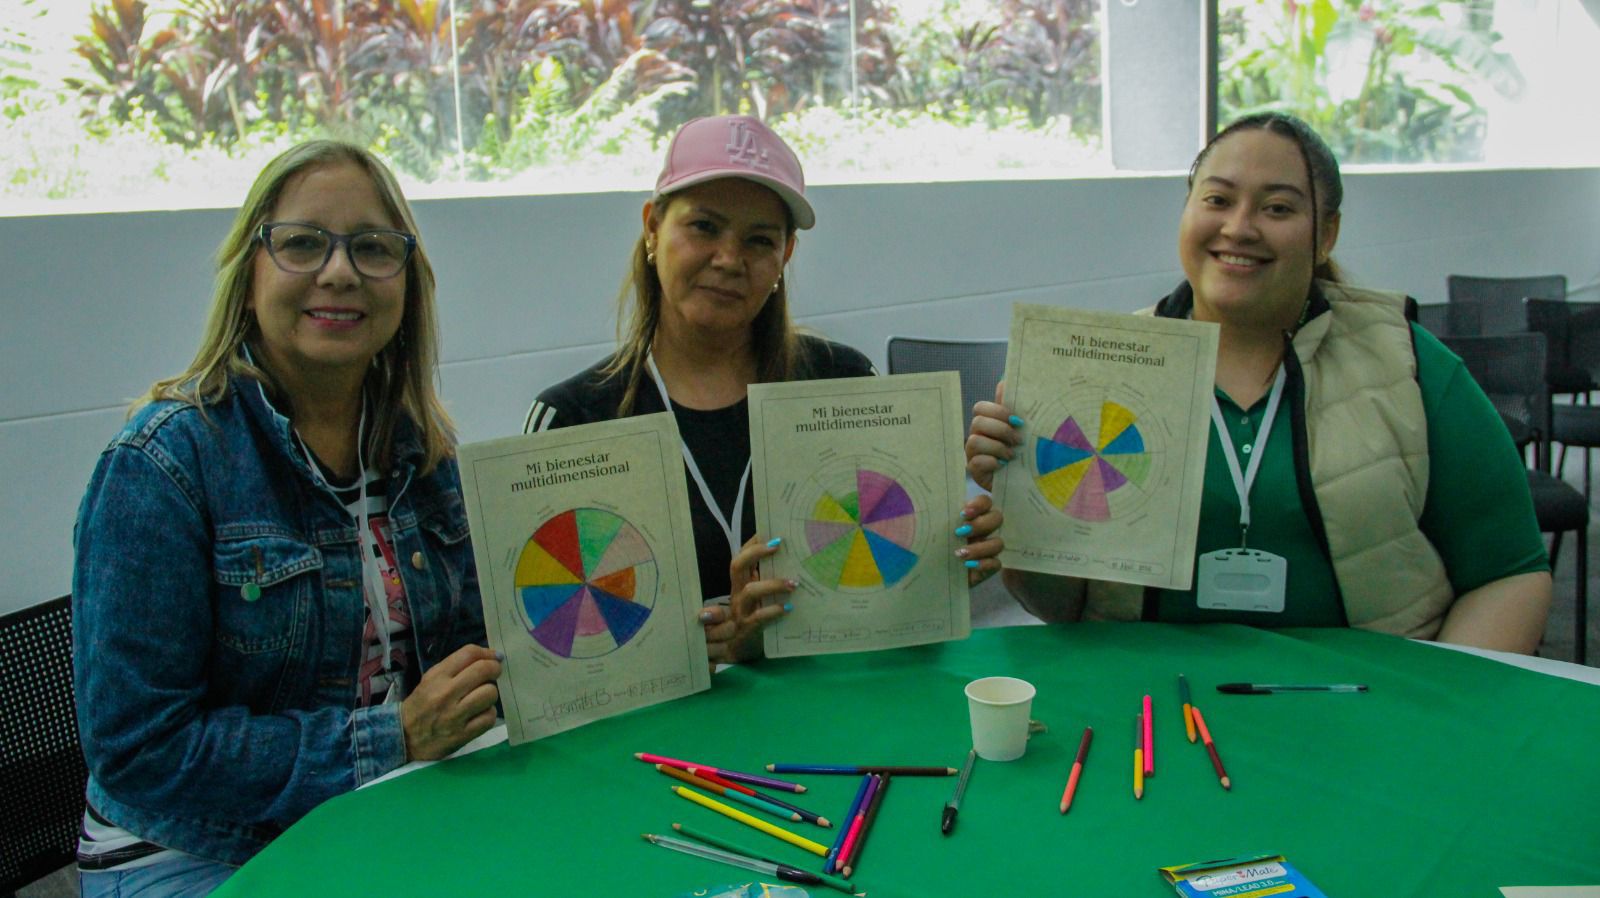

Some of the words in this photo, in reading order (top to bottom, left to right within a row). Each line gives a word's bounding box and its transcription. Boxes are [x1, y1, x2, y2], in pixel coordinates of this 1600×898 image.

[725, 119, 769, 169] LA
[1070, 334, 1085, 346] Mi
[1089, 337, 1151, 353] bienestar
[1052, 346, 1165, 367] multidimensional
[812, 406, 827, 418] Mi
[832, 404, 894, 417] bienestar
[796, 413, 911, 432] multidimensional
[526, 462, 541, 475] Mi
[546, 452, 610, 471] bienestar
[511, 461, 630, 492] multidimensional
[1246, 867, 1278, 878] Mate
[1213, 882, 1260, 896] MINA/LEAD
